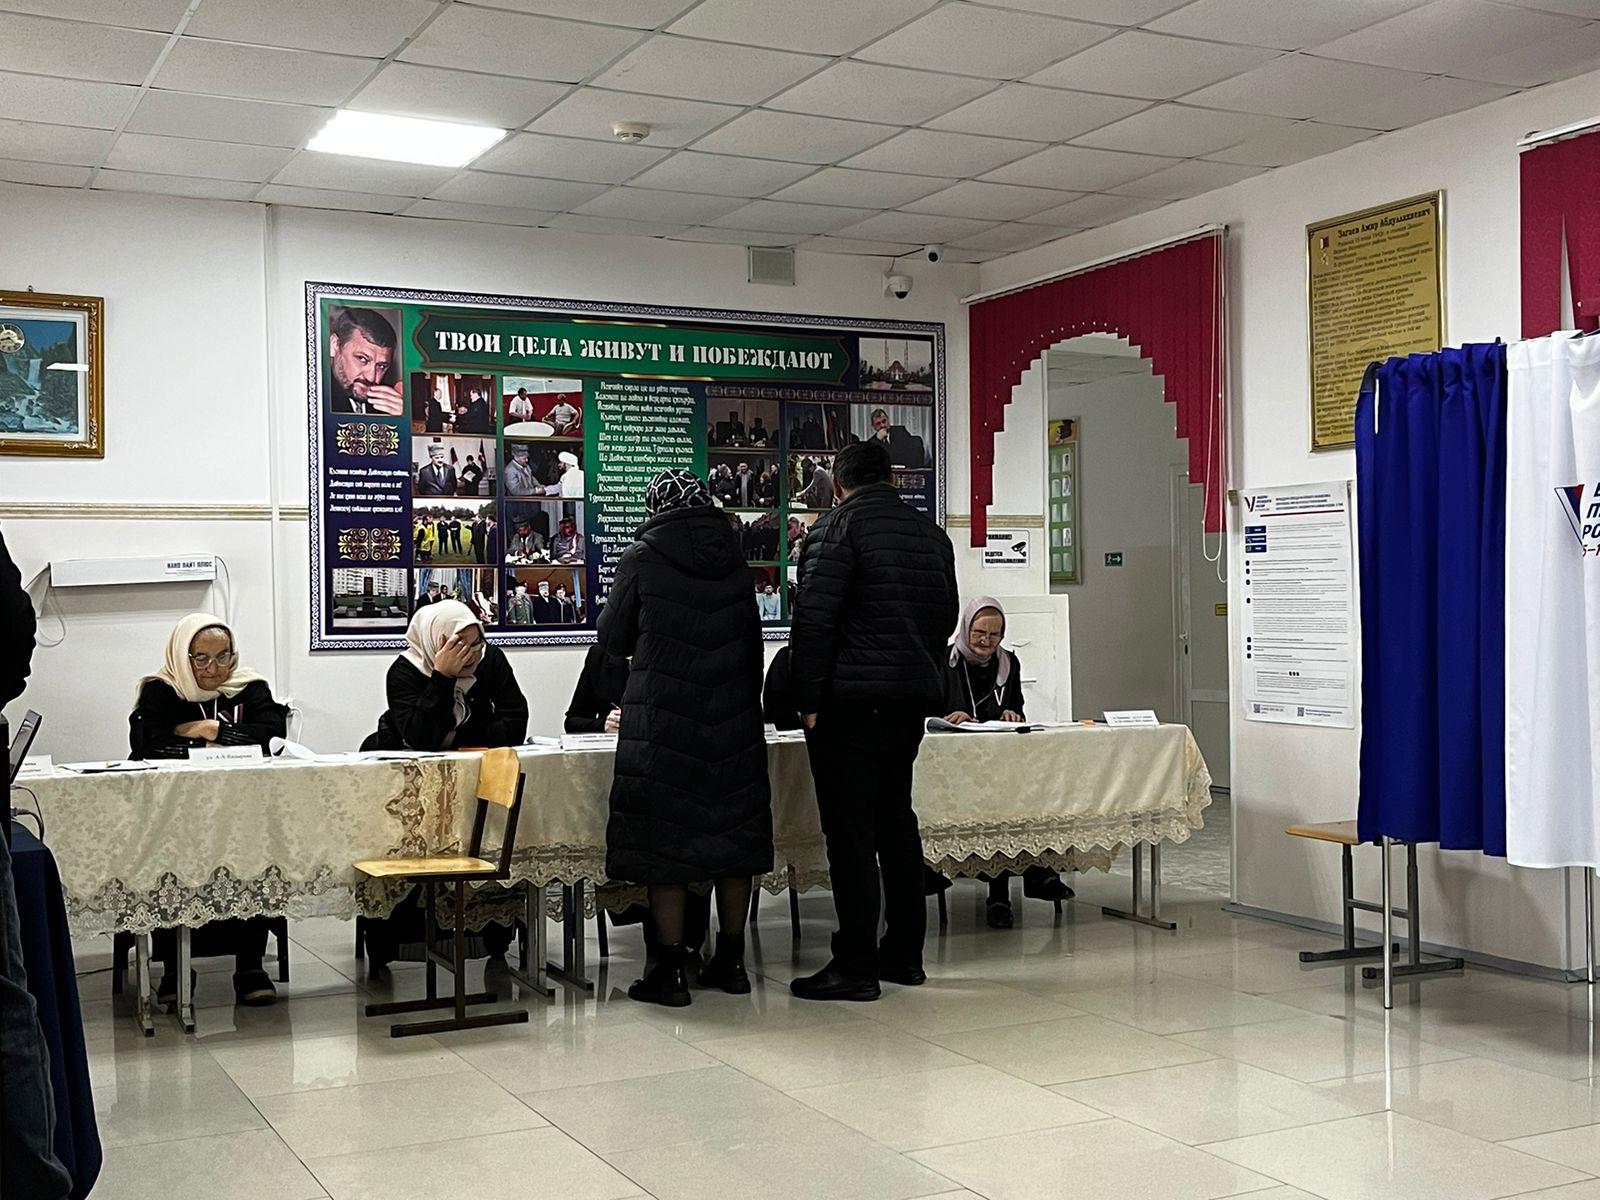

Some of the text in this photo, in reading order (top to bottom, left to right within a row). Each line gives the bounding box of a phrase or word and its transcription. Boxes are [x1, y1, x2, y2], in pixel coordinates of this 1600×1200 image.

[435, 331, 833, 370] ТВОИ ДЕЛА ЖИВУТ И ПОБЕЖДАЮТ
